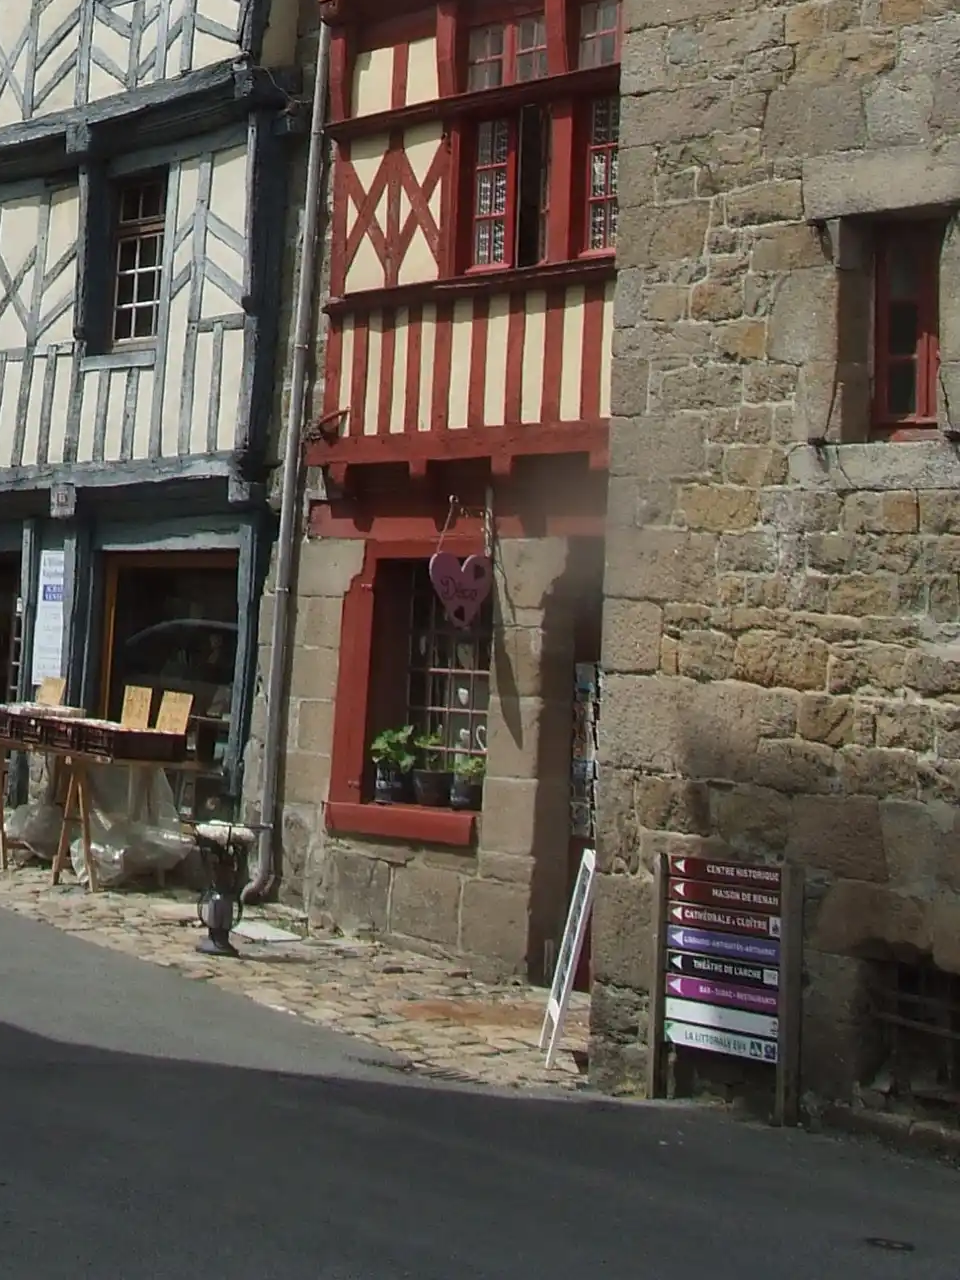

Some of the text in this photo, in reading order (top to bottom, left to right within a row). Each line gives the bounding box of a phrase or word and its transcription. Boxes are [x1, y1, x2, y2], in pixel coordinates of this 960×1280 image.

[706, 864, 780, 881] CENTRE HISTORIQUE
[712, 888, 779, 906] MAISON DE RENAN
[724, 964, 734, 975] DE
[699, 985, 711, 994] BAR
[684, 1029, 694, 1041] LA
